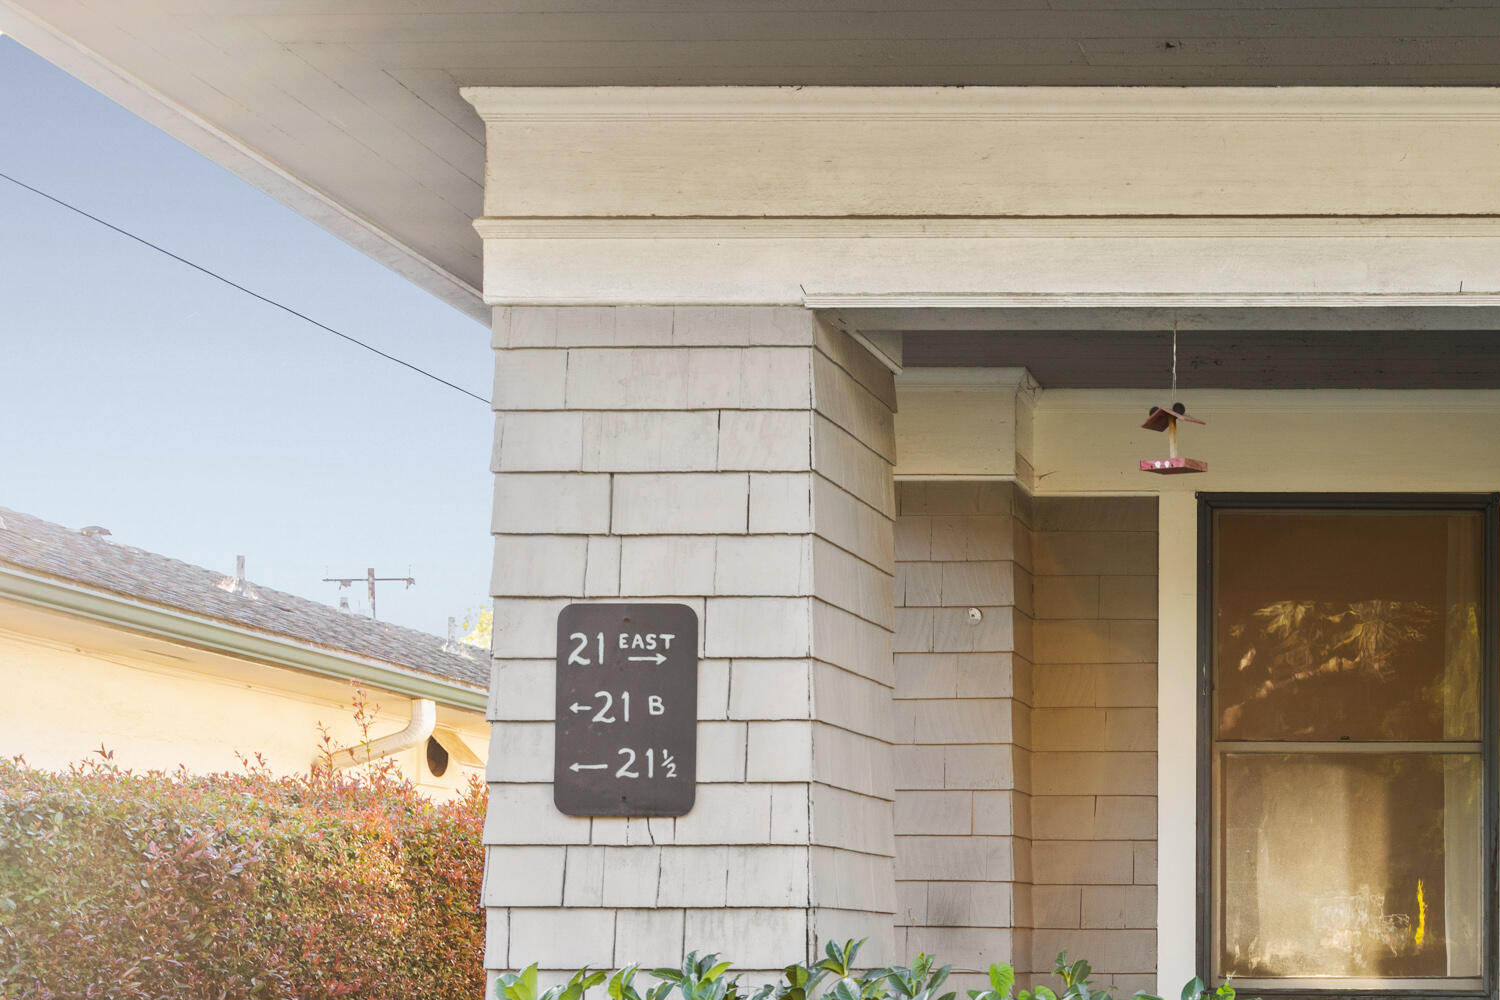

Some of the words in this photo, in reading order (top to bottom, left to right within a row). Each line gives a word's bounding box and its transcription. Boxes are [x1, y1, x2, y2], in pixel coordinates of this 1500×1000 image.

[567, 631, 605, 665] 21
[618, 632, 676, 650] EAST
[591, 690, 630, 723] 21
[648, 695, 665, 716] B
